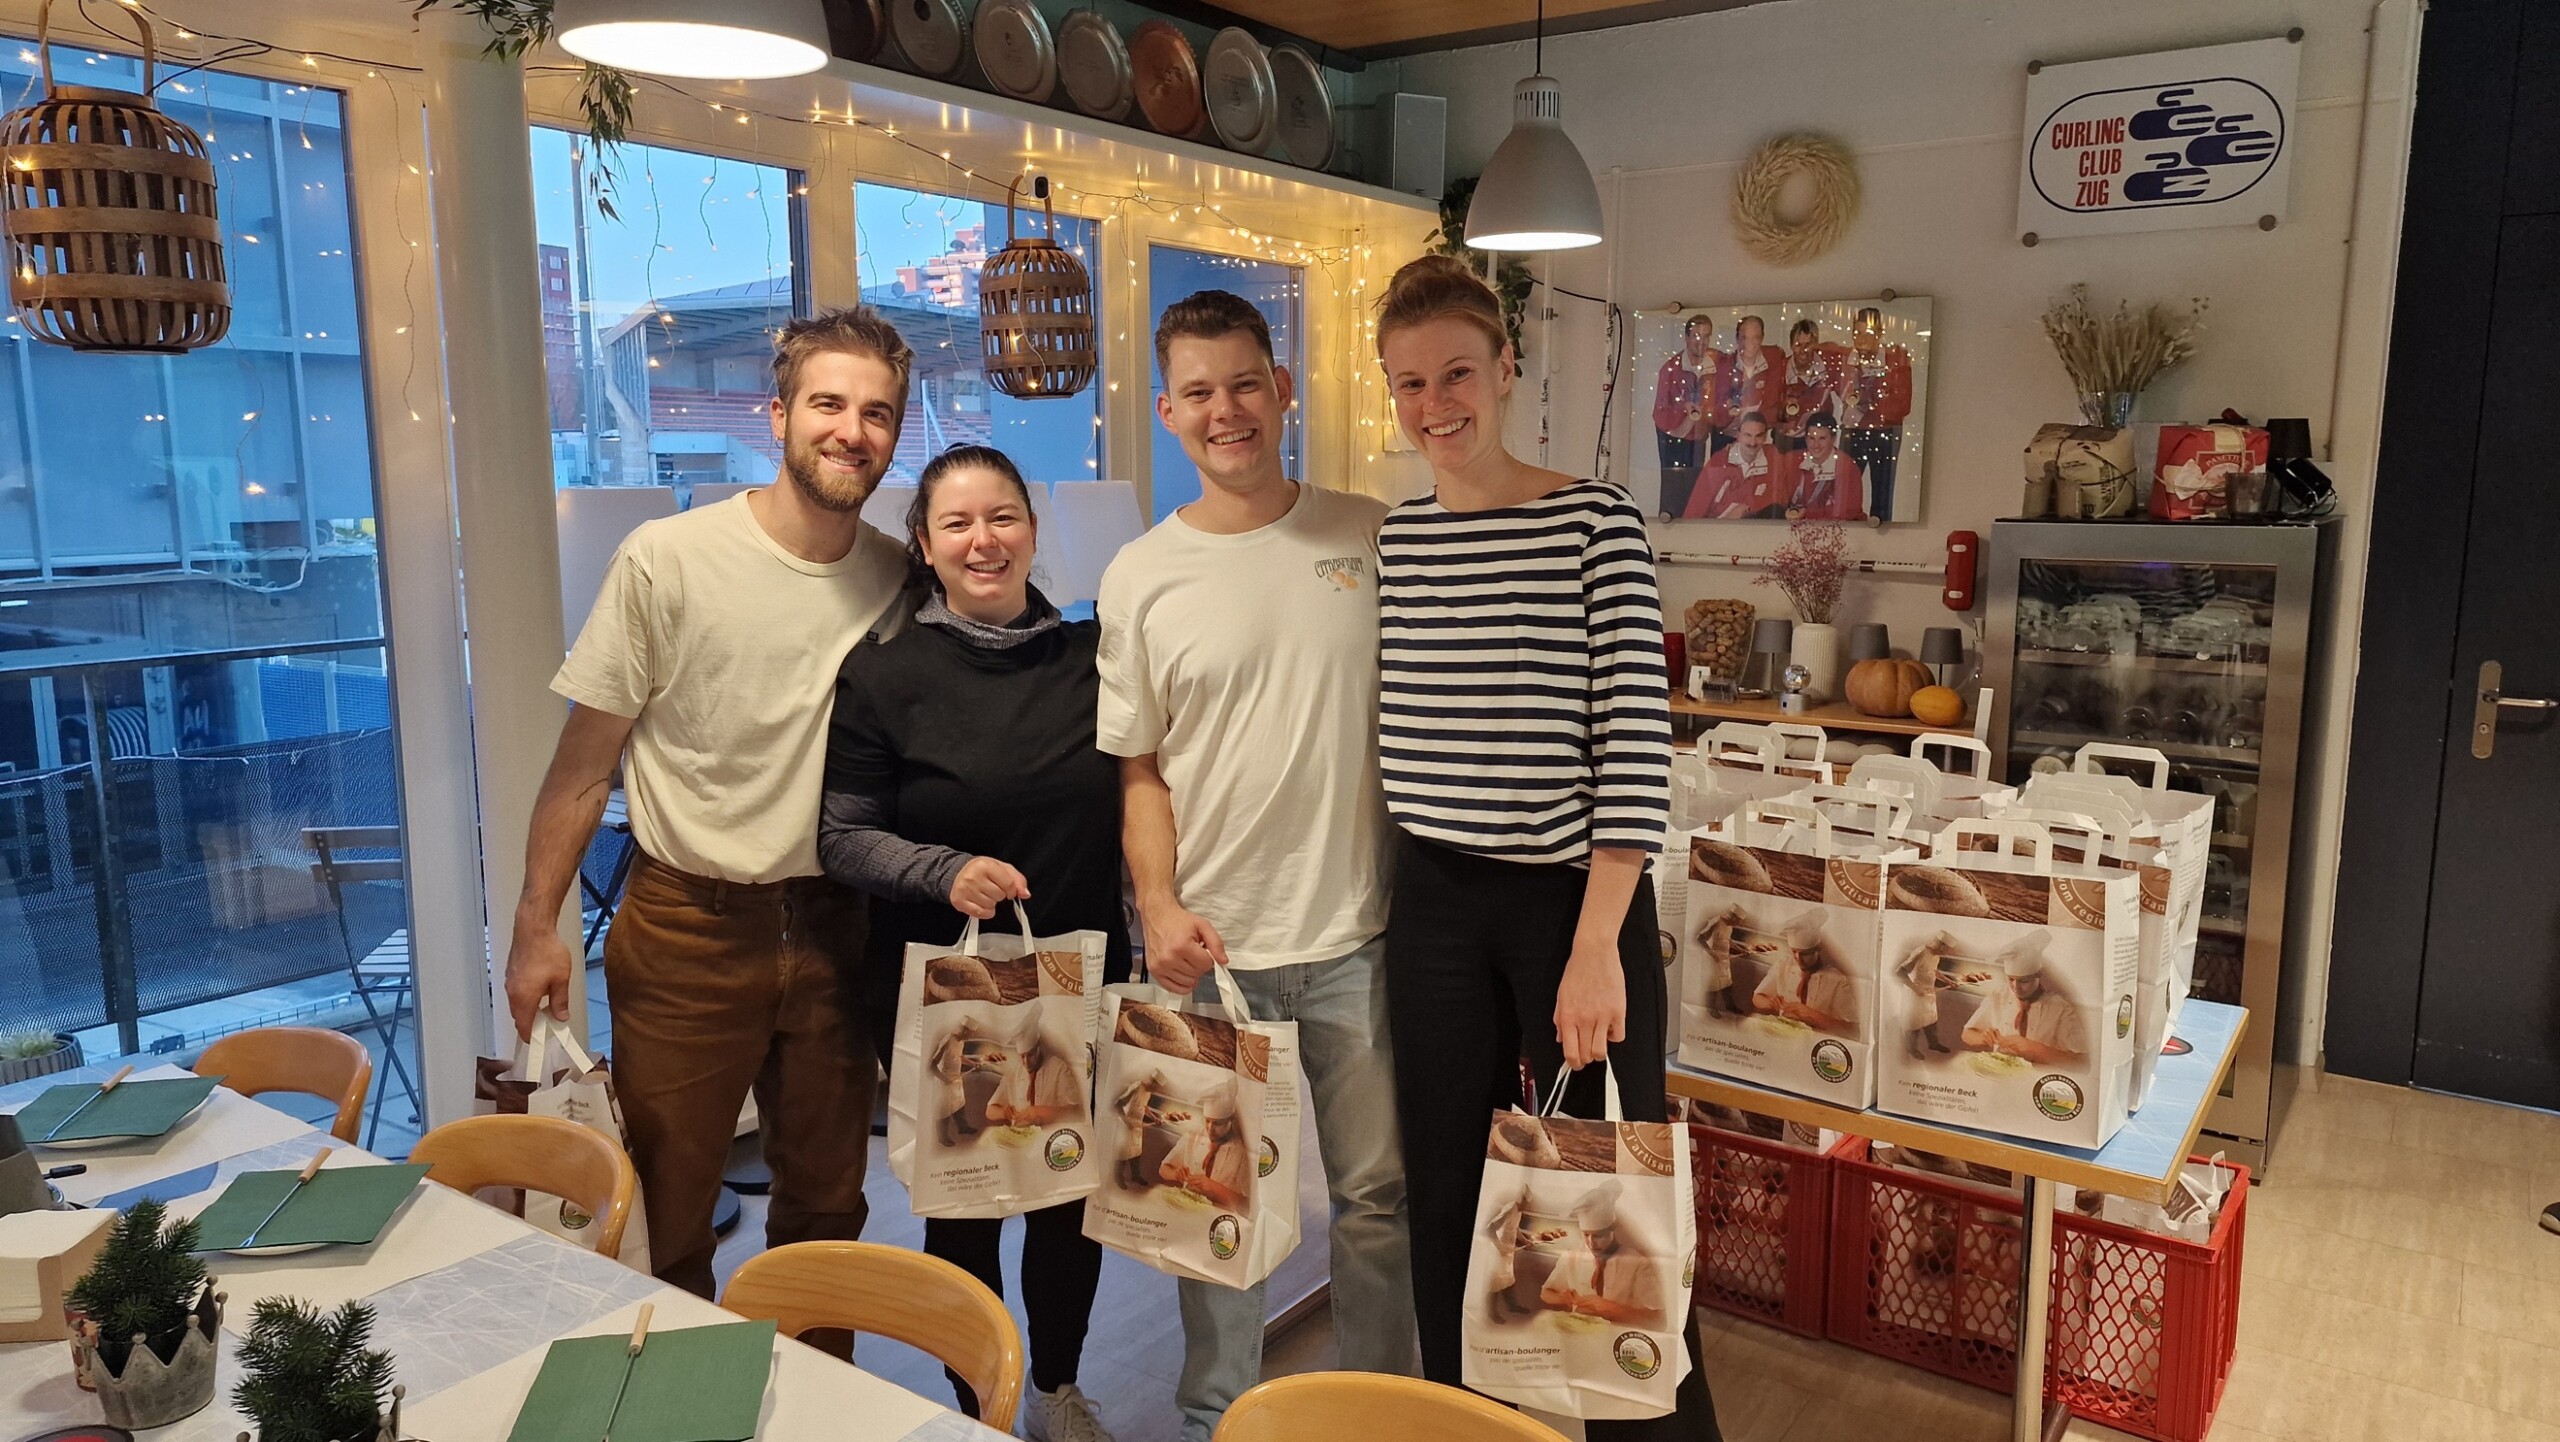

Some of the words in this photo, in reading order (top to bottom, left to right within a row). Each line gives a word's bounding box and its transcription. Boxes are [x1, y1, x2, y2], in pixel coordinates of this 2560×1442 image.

[2052, 117, 2125, 150] CURLING
[2079, 149, 2122, 178] CLUB
[2075, 179, 2109, 207] ZUG
[1912, 1082, 1956, 1095] regionaler
[1627, 1134, 1672, 1173] l'artisan
[943, 1165, 983, 1177] regionaler
